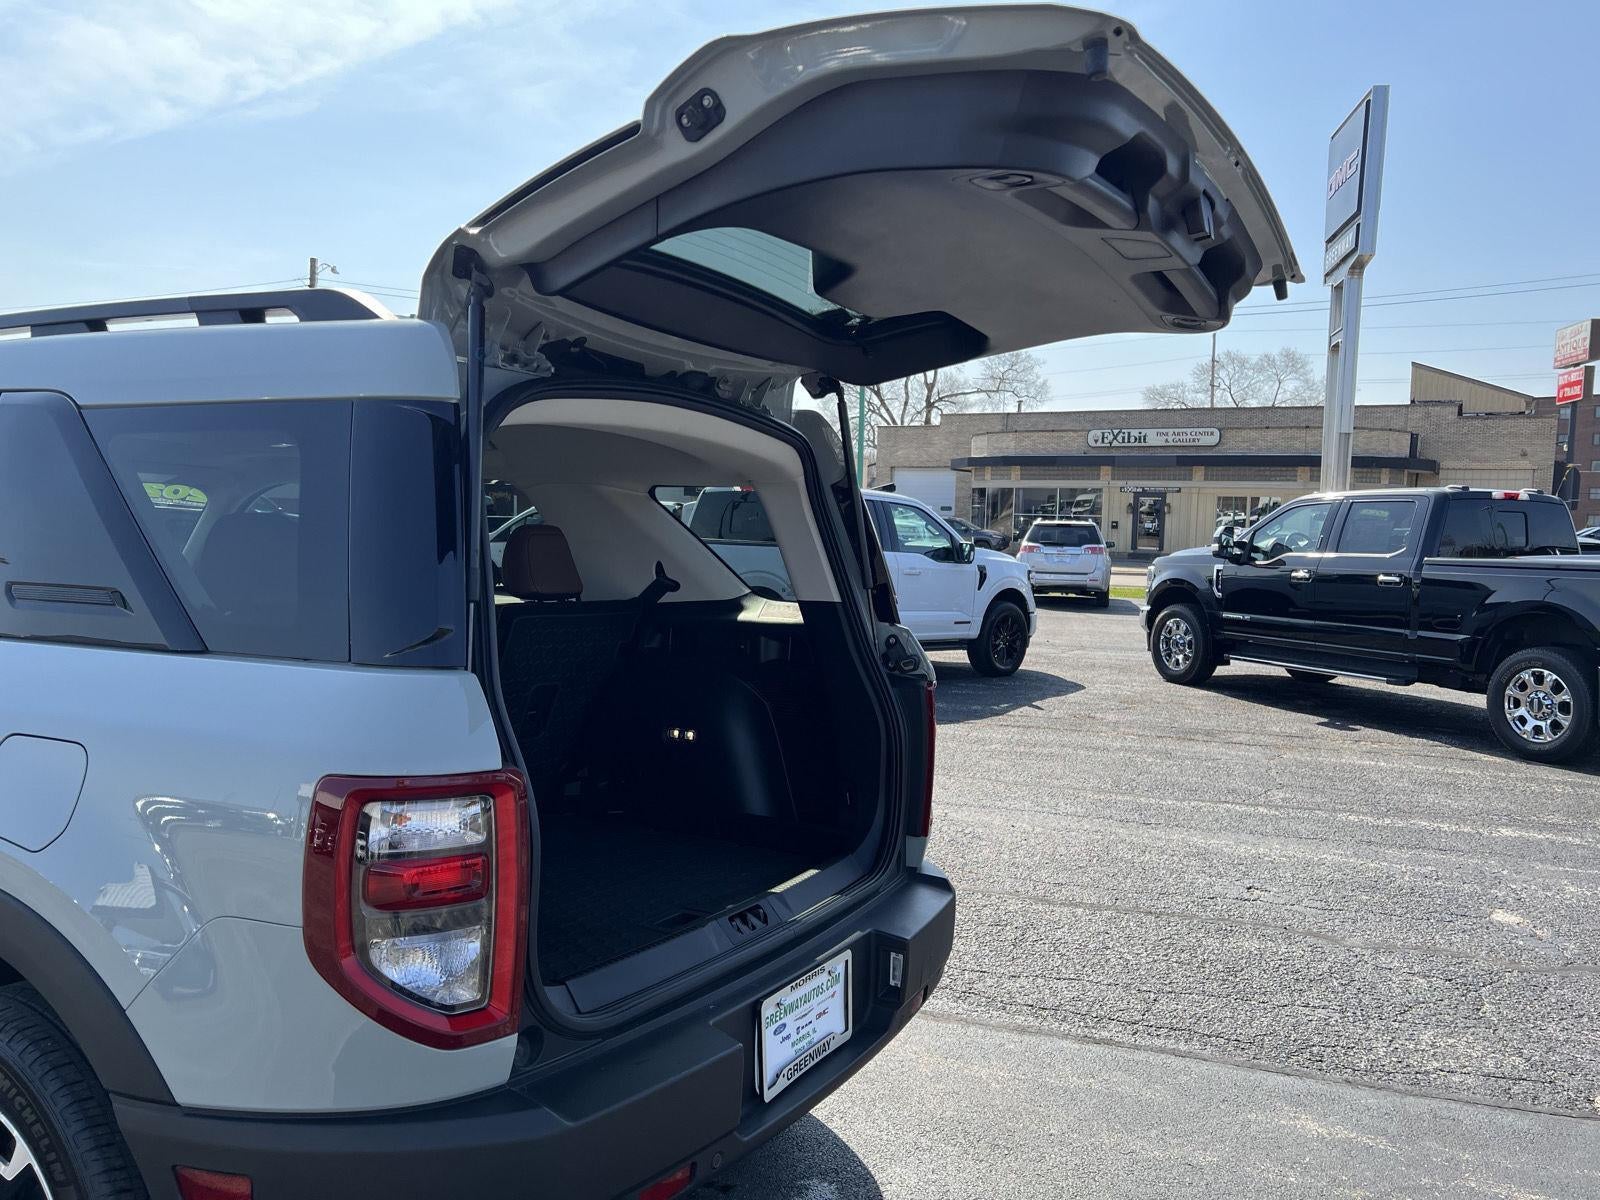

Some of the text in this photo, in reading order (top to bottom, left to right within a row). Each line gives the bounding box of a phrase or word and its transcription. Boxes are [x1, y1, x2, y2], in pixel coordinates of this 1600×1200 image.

[1328, 147, 1360, 200] GMC
[765, 972, 841, 1030] GREENWAYAUTOS.COM
[790, 965, 826, 992] MORRIS
[786, 1038, 832, 1081] GREENWAY
